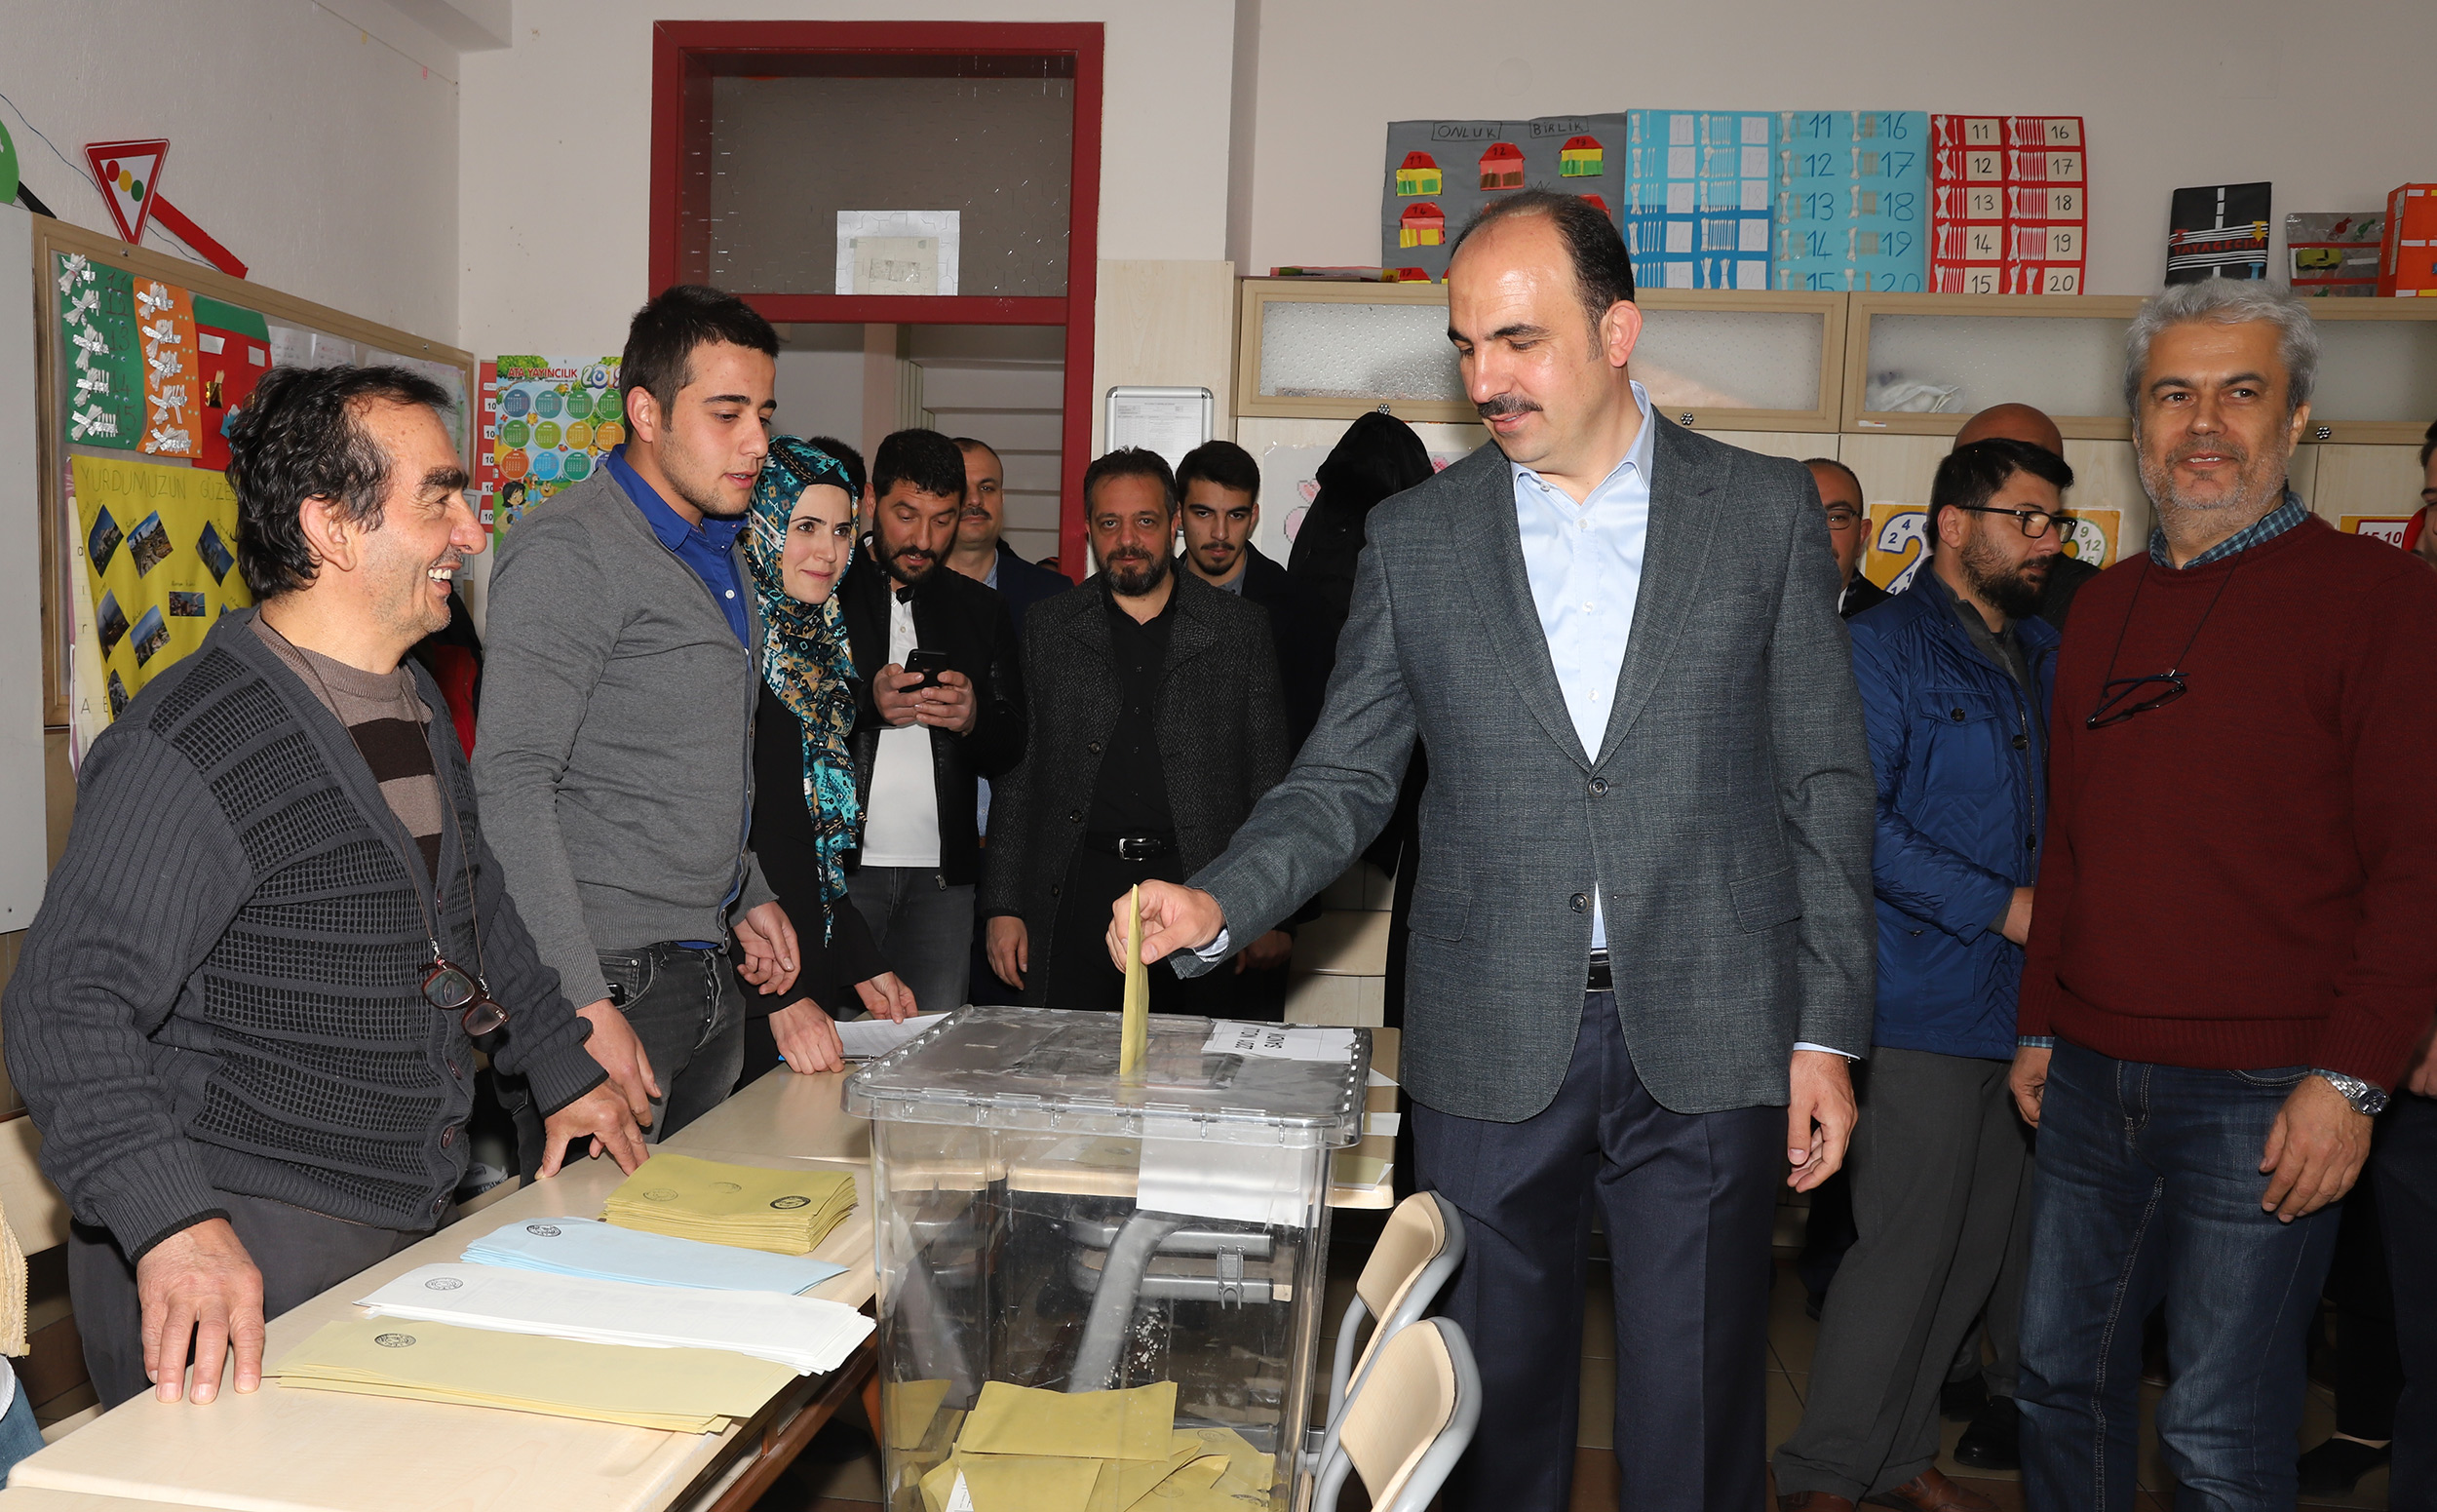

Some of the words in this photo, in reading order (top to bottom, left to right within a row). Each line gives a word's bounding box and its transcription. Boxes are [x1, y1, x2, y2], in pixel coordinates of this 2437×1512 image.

[1437, 125, 1498, 138] ONLUK
[1809, 113, 1832, 138] 11
[1882, 112, 1908, 139] 16
[1973, 124, 1989, 139] 11
[2051, 126, 2070, 139] 16
[1805, 153, 1835, 177] 12
[1881, 151, 1915, 178] 17
[1974, 158, 1992, 174] 12
[2052, 158, 2073, 174] 17
[1805, 192, 1835, 220] 13
[1883, 192, 1915, 221] 18
[1973, 195, 1994, 211] 13
[2054, 195, 2072, 211] 18
[1806, 231, 1833, 260] 14
[1882, 231, 1913, 258] 19
[1974, 234, 1992, 254] 14
[2053, 234, 2071, 252] 19
[1806, 272, 1836, 291] 15
[1880, 273, 1921, 292] 20
[1971, 275, 1992, 293] 15
[2049, 275, 2074, 291] 20
[508, 368, 524, 378] ATA
[527, 368, 578, 379] YAYINCILIK
[81, 466, 187, 500] YURDUMUZUN
[1902, 519, 1911, 530] 4
[2080, 526, 2089, 537] 9
[1888, 532, 1898, 544] 2
[2085, 539, 2101, 551] 12
[2384, 531, 2403, 544] 10
